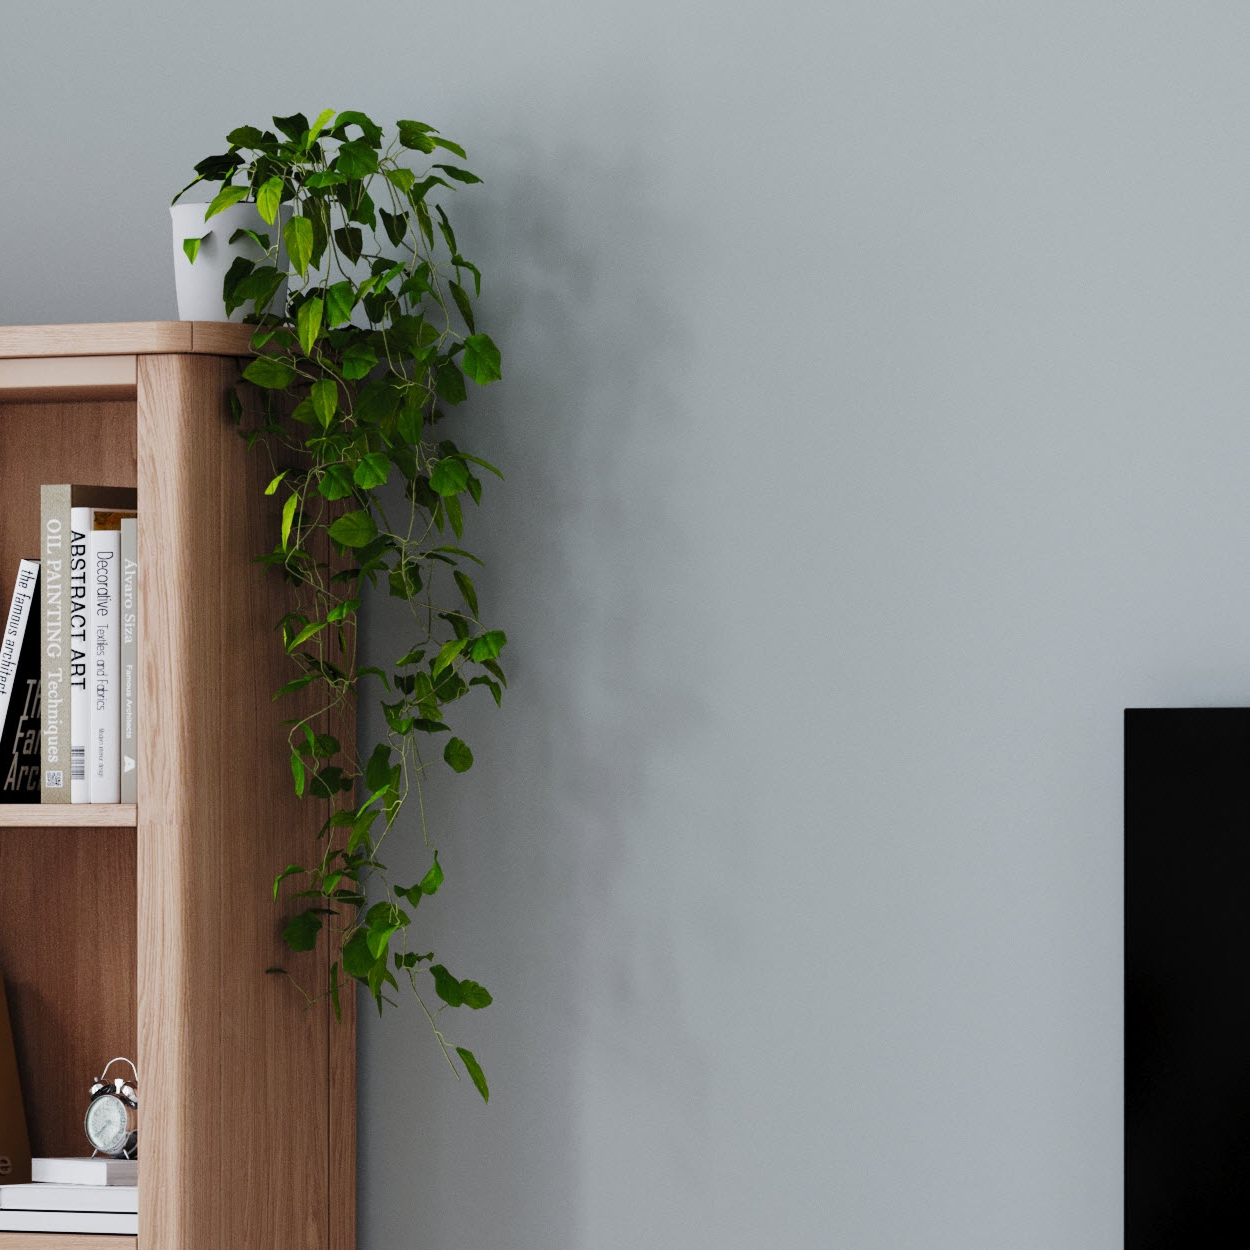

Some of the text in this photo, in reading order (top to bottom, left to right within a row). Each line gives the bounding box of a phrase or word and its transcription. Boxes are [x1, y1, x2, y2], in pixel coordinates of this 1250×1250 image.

[8, 592, 31, 636] famous
[18, 569, 35, 589] the
[71, 530, 86, 690] ABSTRACT ART
[124, 557, 138, 644] Álvaro Siza
[44, 519, 63, 763] OIL PAINTING Techniques
[96, 551, 114, 711] Decorative Textiles and Fabrics
[125, 664, 134, 739] Famous Architects
